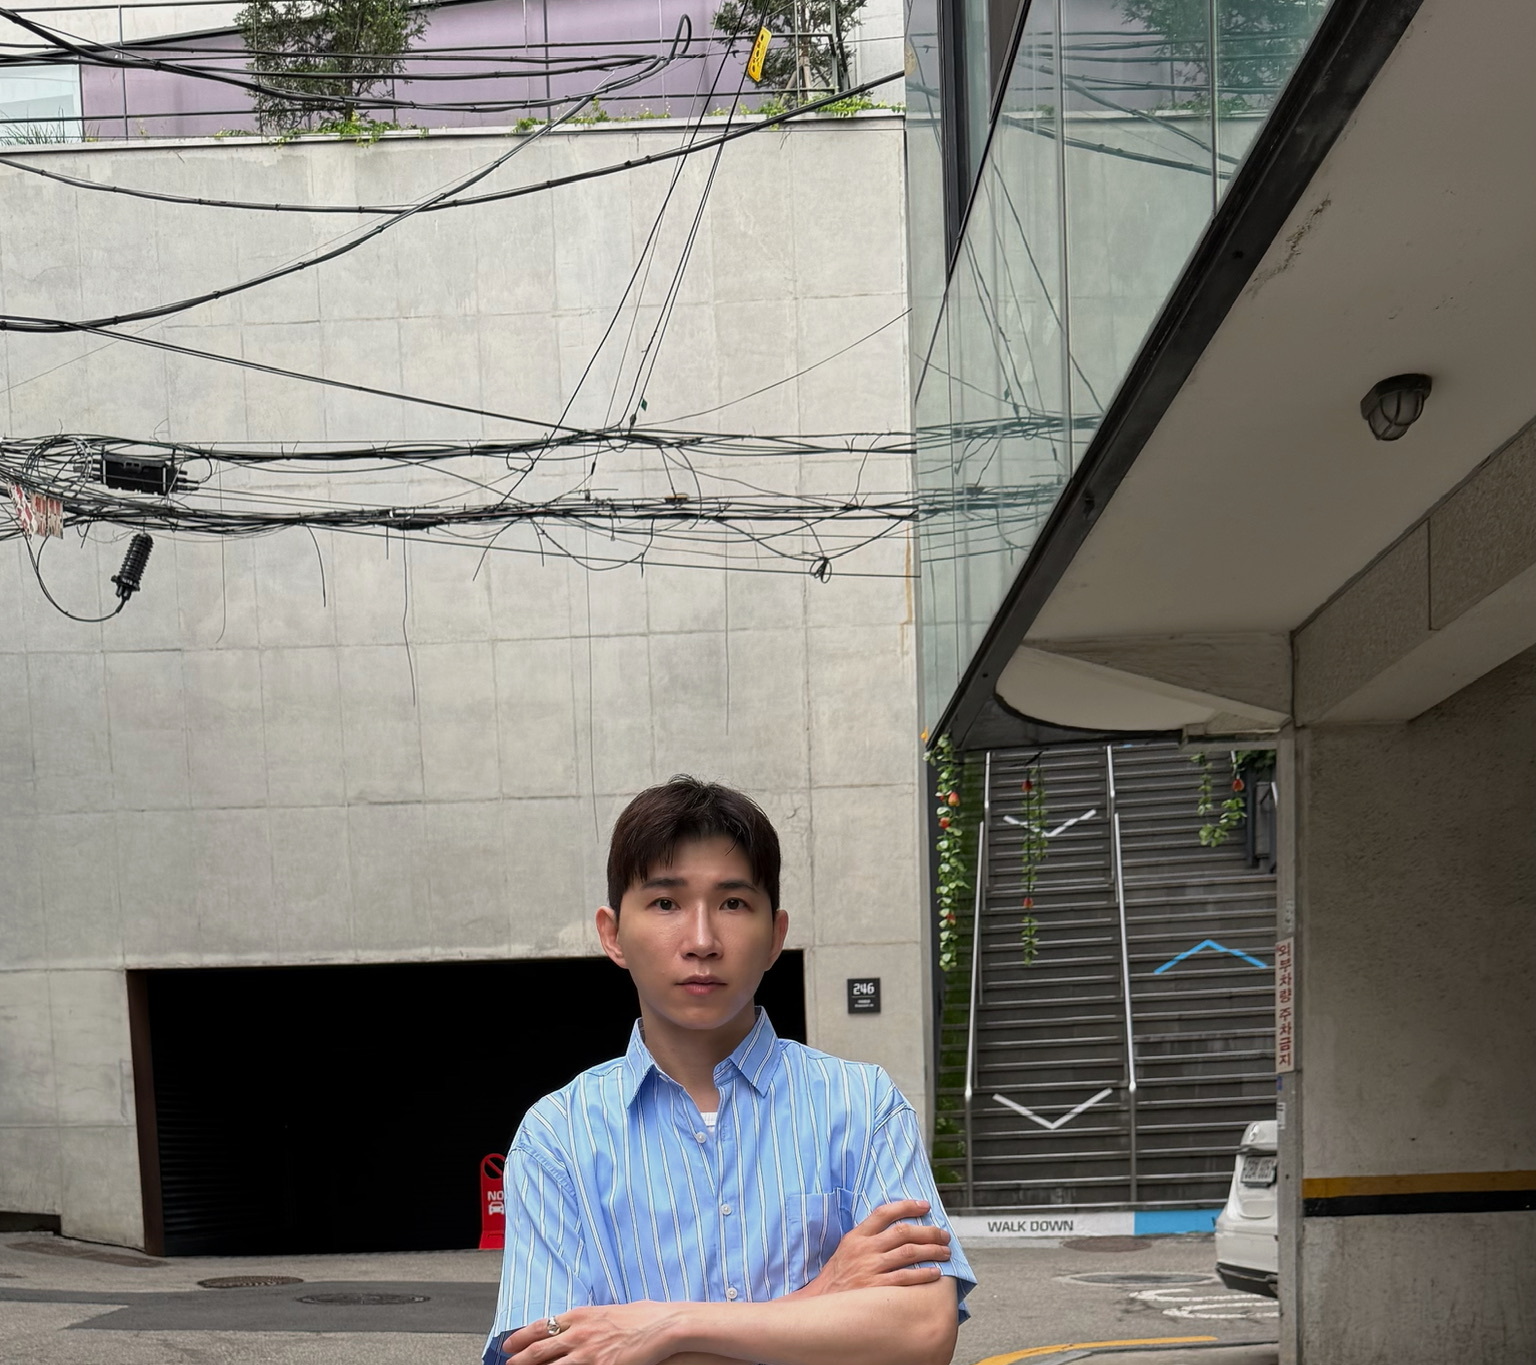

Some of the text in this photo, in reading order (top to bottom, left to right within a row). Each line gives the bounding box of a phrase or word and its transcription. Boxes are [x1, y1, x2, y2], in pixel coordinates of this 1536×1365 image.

[853, 982, 875, 995] 246
[1279, 942, 1292, 1067] 외부차량 주차금지
[487, 1190, 504, 1201] NO
[987, 1220, 1074, 1232] WALK DOWN
